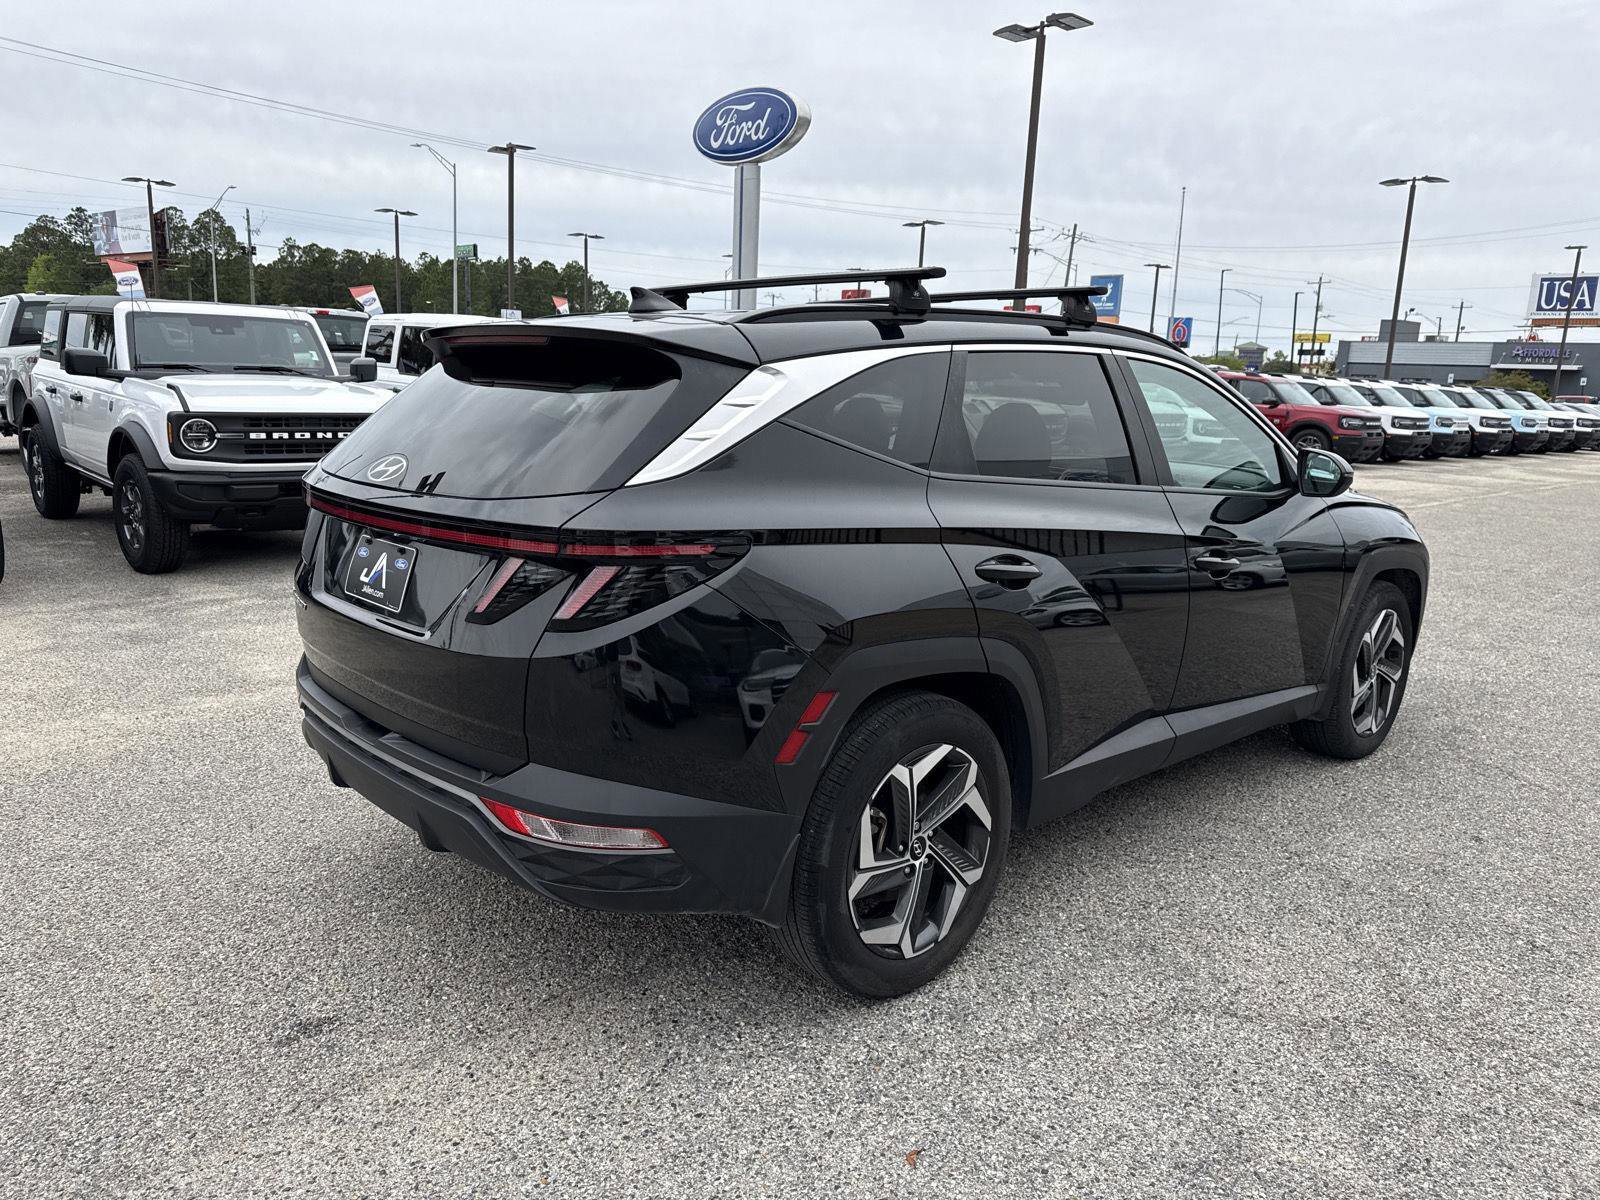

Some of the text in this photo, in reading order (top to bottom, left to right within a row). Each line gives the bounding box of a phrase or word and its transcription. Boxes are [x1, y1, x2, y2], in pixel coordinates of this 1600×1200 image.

[710, 101, 772, 149] Ford
[1541, 280, 1591, 310] USA
[1171, 319, 1188, 342] 6
